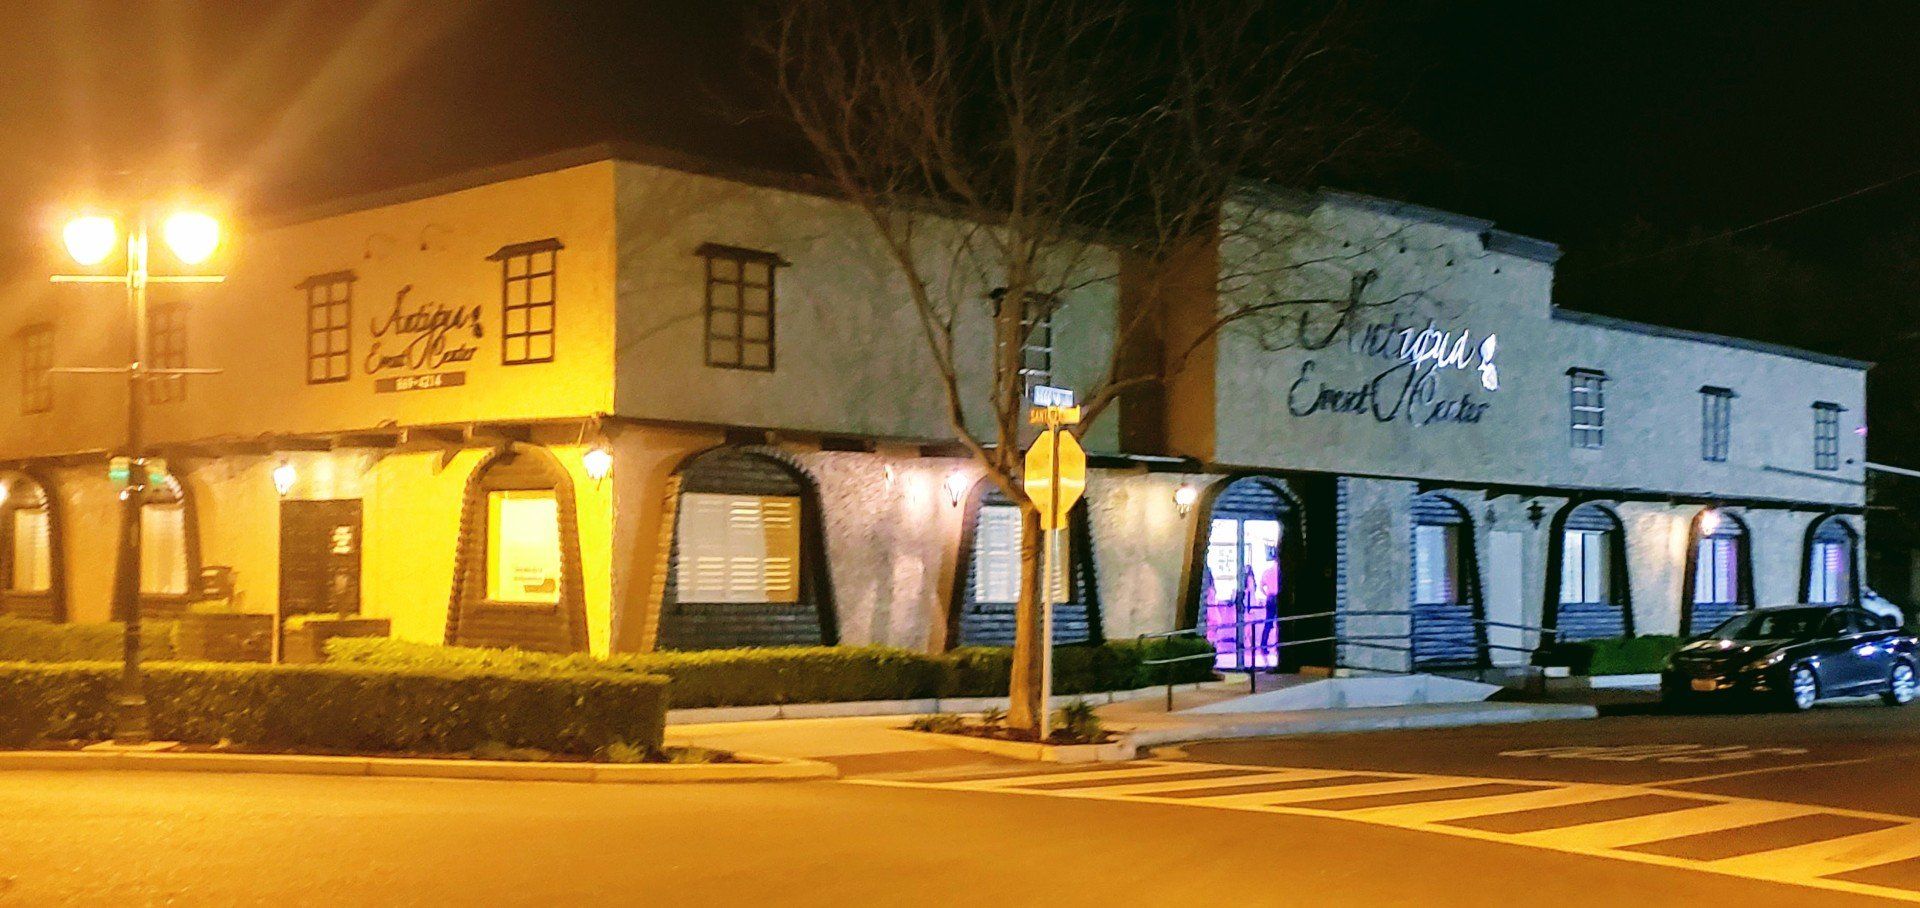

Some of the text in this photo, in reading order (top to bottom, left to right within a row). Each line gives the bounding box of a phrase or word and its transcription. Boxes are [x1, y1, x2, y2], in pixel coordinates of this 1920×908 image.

[364, 334, 478, 374] Event Center
[370, 285, 474, 352] Antigua
[1299, 268, 1475, 385] Antigua
[1287, 350, 1491, 428] Event Center
